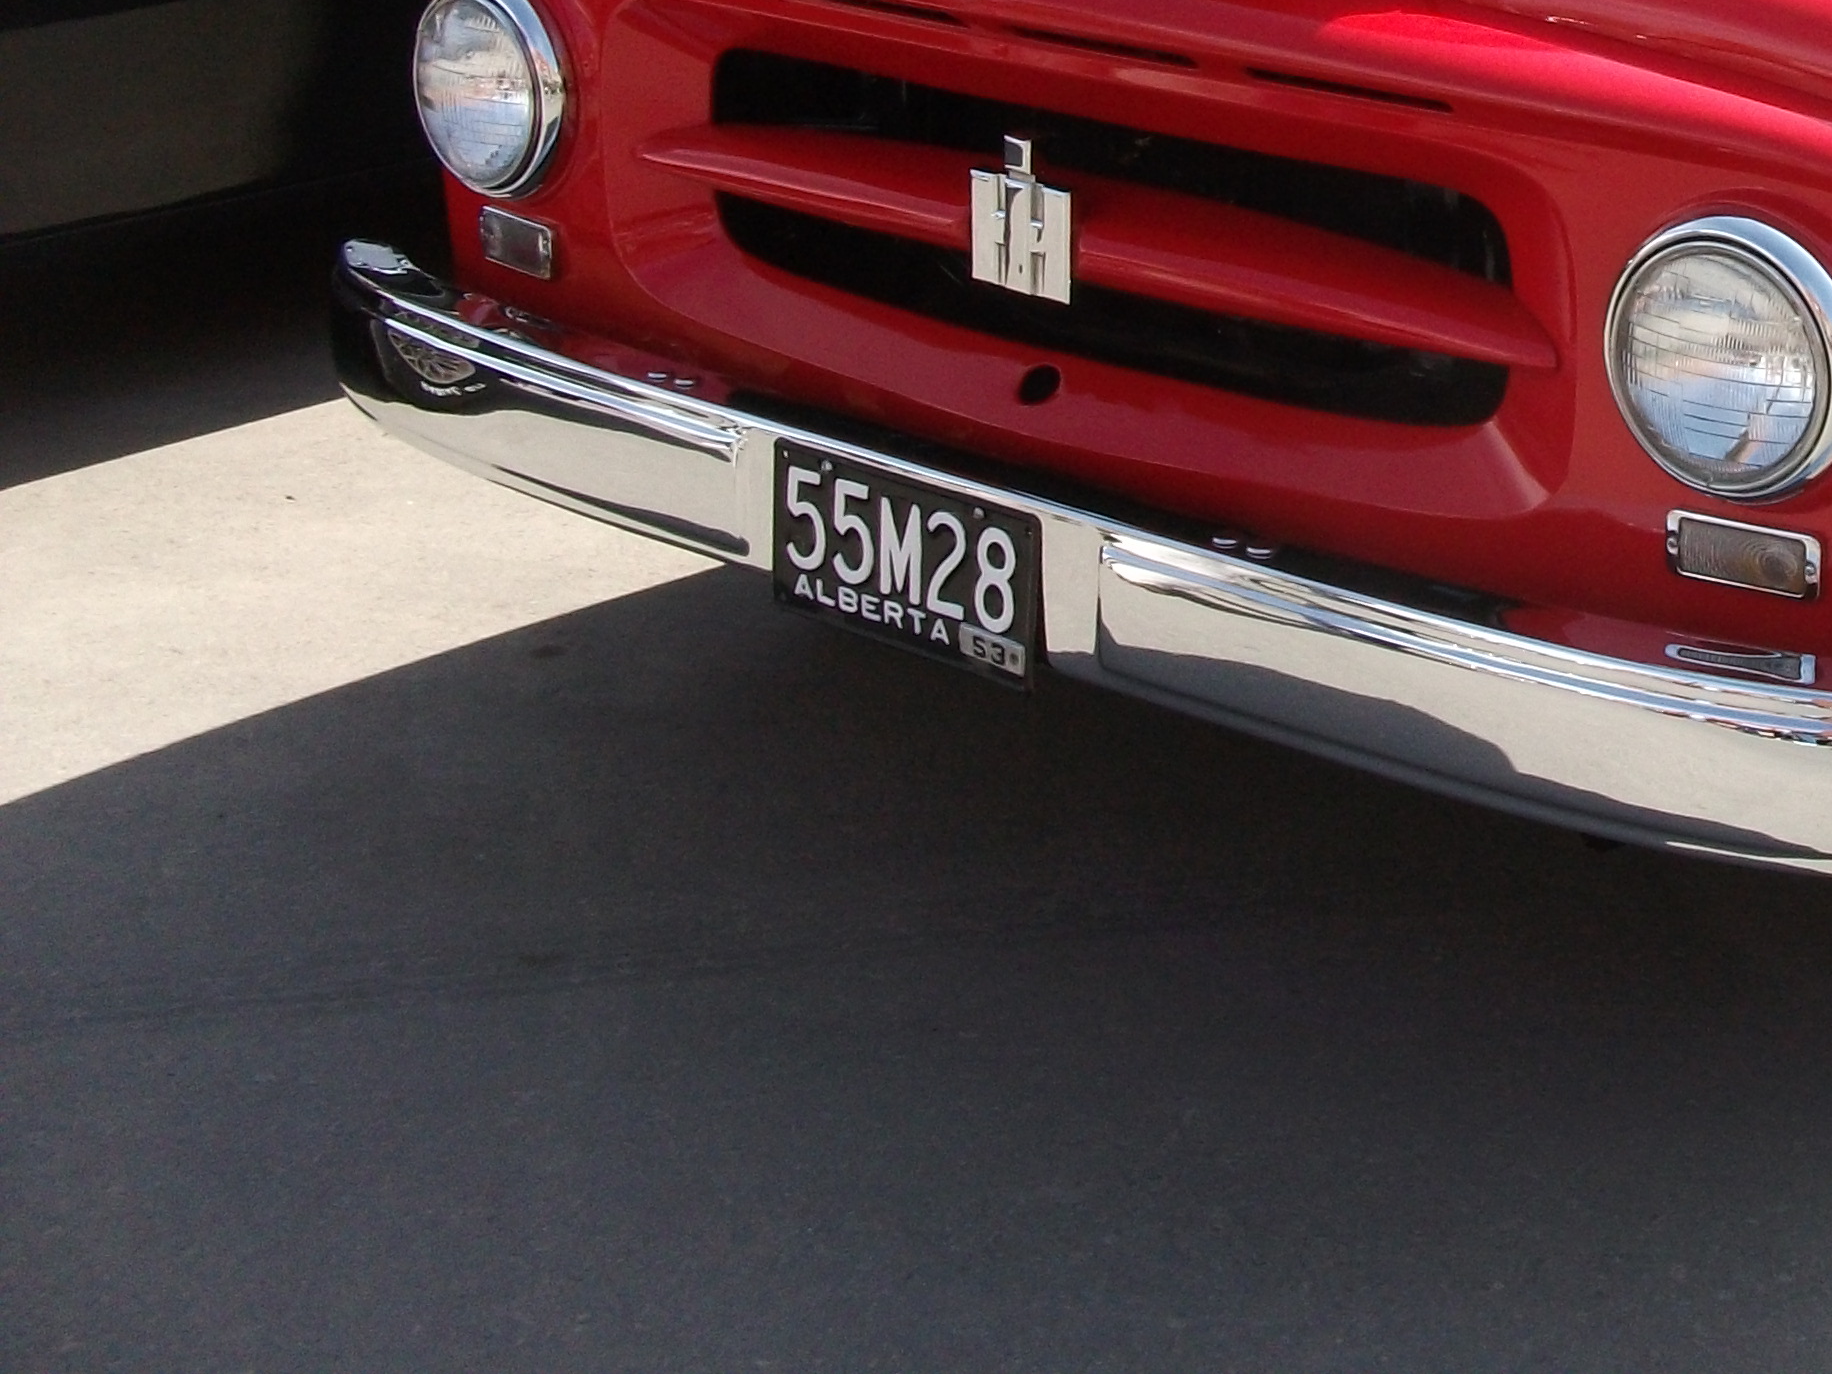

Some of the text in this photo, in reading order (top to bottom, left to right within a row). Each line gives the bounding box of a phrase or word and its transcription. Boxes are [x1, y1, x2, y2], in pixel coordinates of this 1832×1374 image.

[785, 466, 1017, 634] 55M28
[795, 573, 951, 646] ALBERTA
[972, 640, 1006, 667] 53
